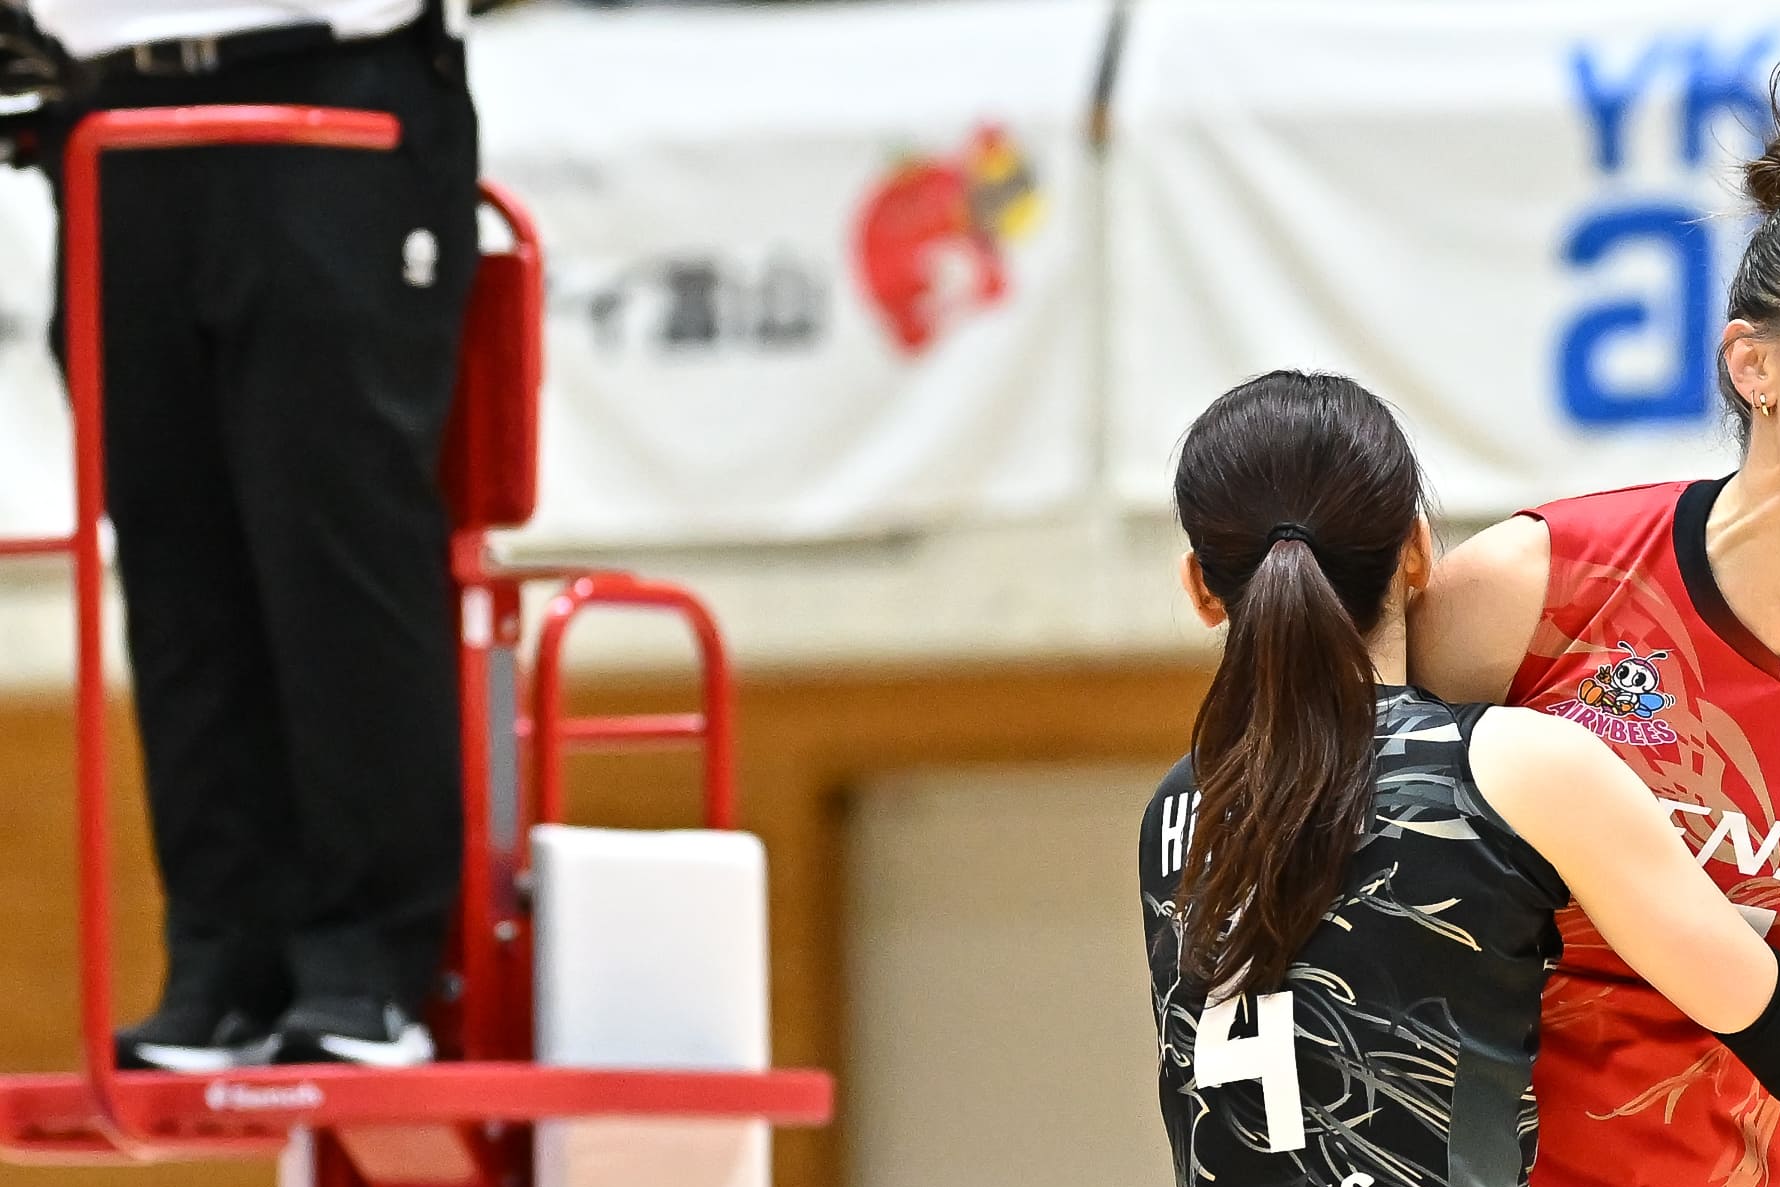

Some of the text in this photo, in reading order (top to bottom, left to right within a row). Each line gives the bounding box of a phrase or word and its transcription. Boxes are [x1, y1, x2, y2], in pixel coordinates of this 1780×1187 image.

[1552, 203, 1716, 428] a
[1547, 699, 1677, 745] AIRYBEES
[1194, 990, 1306, 1153] 4
